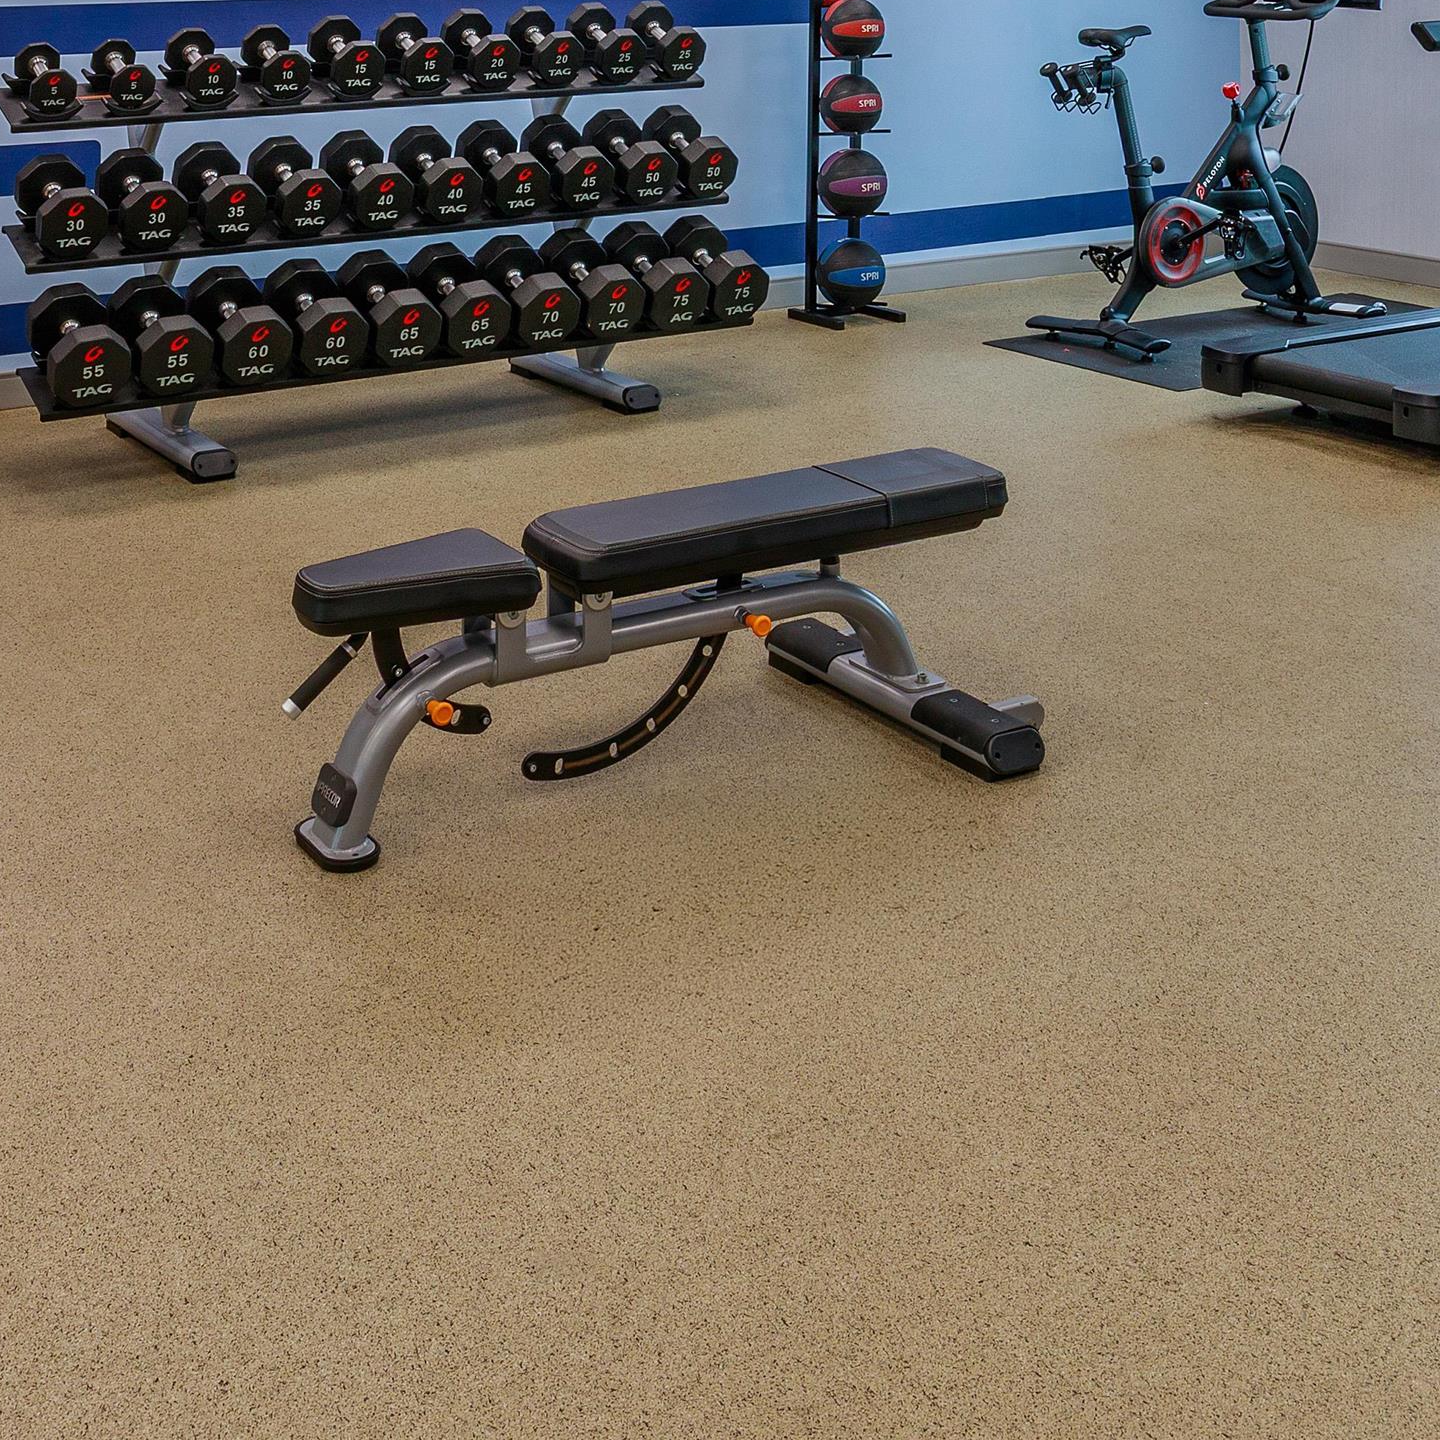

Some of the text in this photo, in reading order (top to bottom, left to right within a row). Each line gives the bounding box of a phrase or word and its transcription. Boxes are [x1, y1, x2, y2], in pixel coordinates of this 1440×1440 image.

[861, 24, 880, 33] SPRI
[556, 55, 568, 64] 20
[619, 53, 631, 62] 25
[679, 50, 691, 59] 25
[425, 61, 436, 70] 15
[491, 58, 503, 67] 20
[356, 64, 366, 73] 15
[549, 68, 571, 76] TAG
[208, 75, 219, 83] 10
[283, 71, 293, 79] 10
[416, 75, 439, 83] TAG
[484, 72, 507, 80] TAG
[859, 99, 877, 108] SPRI
[707, 167, 720, 177] 50
[1203, 156, 1225, 187] PELOTON
[582, 177, 596, 187] 45
[646, 173, 659, 182] 50
[516, 183, 531, 193] 45
[699, 182, 722, 190] TAG
[861, 183, 881, 192] SPRI
[448, 188, 463, 199] 40
[638, 187, 663, 196] TAG
[378, 195, 393, 205] 40
[573, 192, 599, 202] TAG
[305, 200, 321, 211] 35
[508, 199, 534, 208] TAG
[228, 206, 244, 217] 35
[439, 205, 467, 214] TAG
[149, 213, 165, 224] 30
[368, 211, 397, 220] TAG
[67, 219, 84, 231] 30
[295, 217, 324, 226] TAG
[218, 223, 249, 233] TAG
[139, 229, 171, 240] TAG
[57, 237, 91, 247] TAG
[860, 271, 880, 282] SPRI
[735, 287, 750, 299] 75
[674, 295, 689, 307] 75
[610, 302, 625, 314] 70
[725, 304, 754, 316] TAG
[543, 311, 558, 323] 70
[472, 318, 489, 331] 65
[599, 319, 628, 330] TAG
[401, 327, 418, 340] 65
[532, 329, 562, 340] TAG
[326, 336, 345, 348] 60
[462, 336, 495, 349] TAG
[249, 345, 268, 358] 60
[390, 346, 423, 358] TAG
[168, 354, 188, 368] 55
[315, 355, 349, 366] TAG
[83, 365, 104, 379] 55
[238, 364, 273, 376] TAG
[157, 373, 194, 386] TAG
[72, 384, 112, 398] TAG
